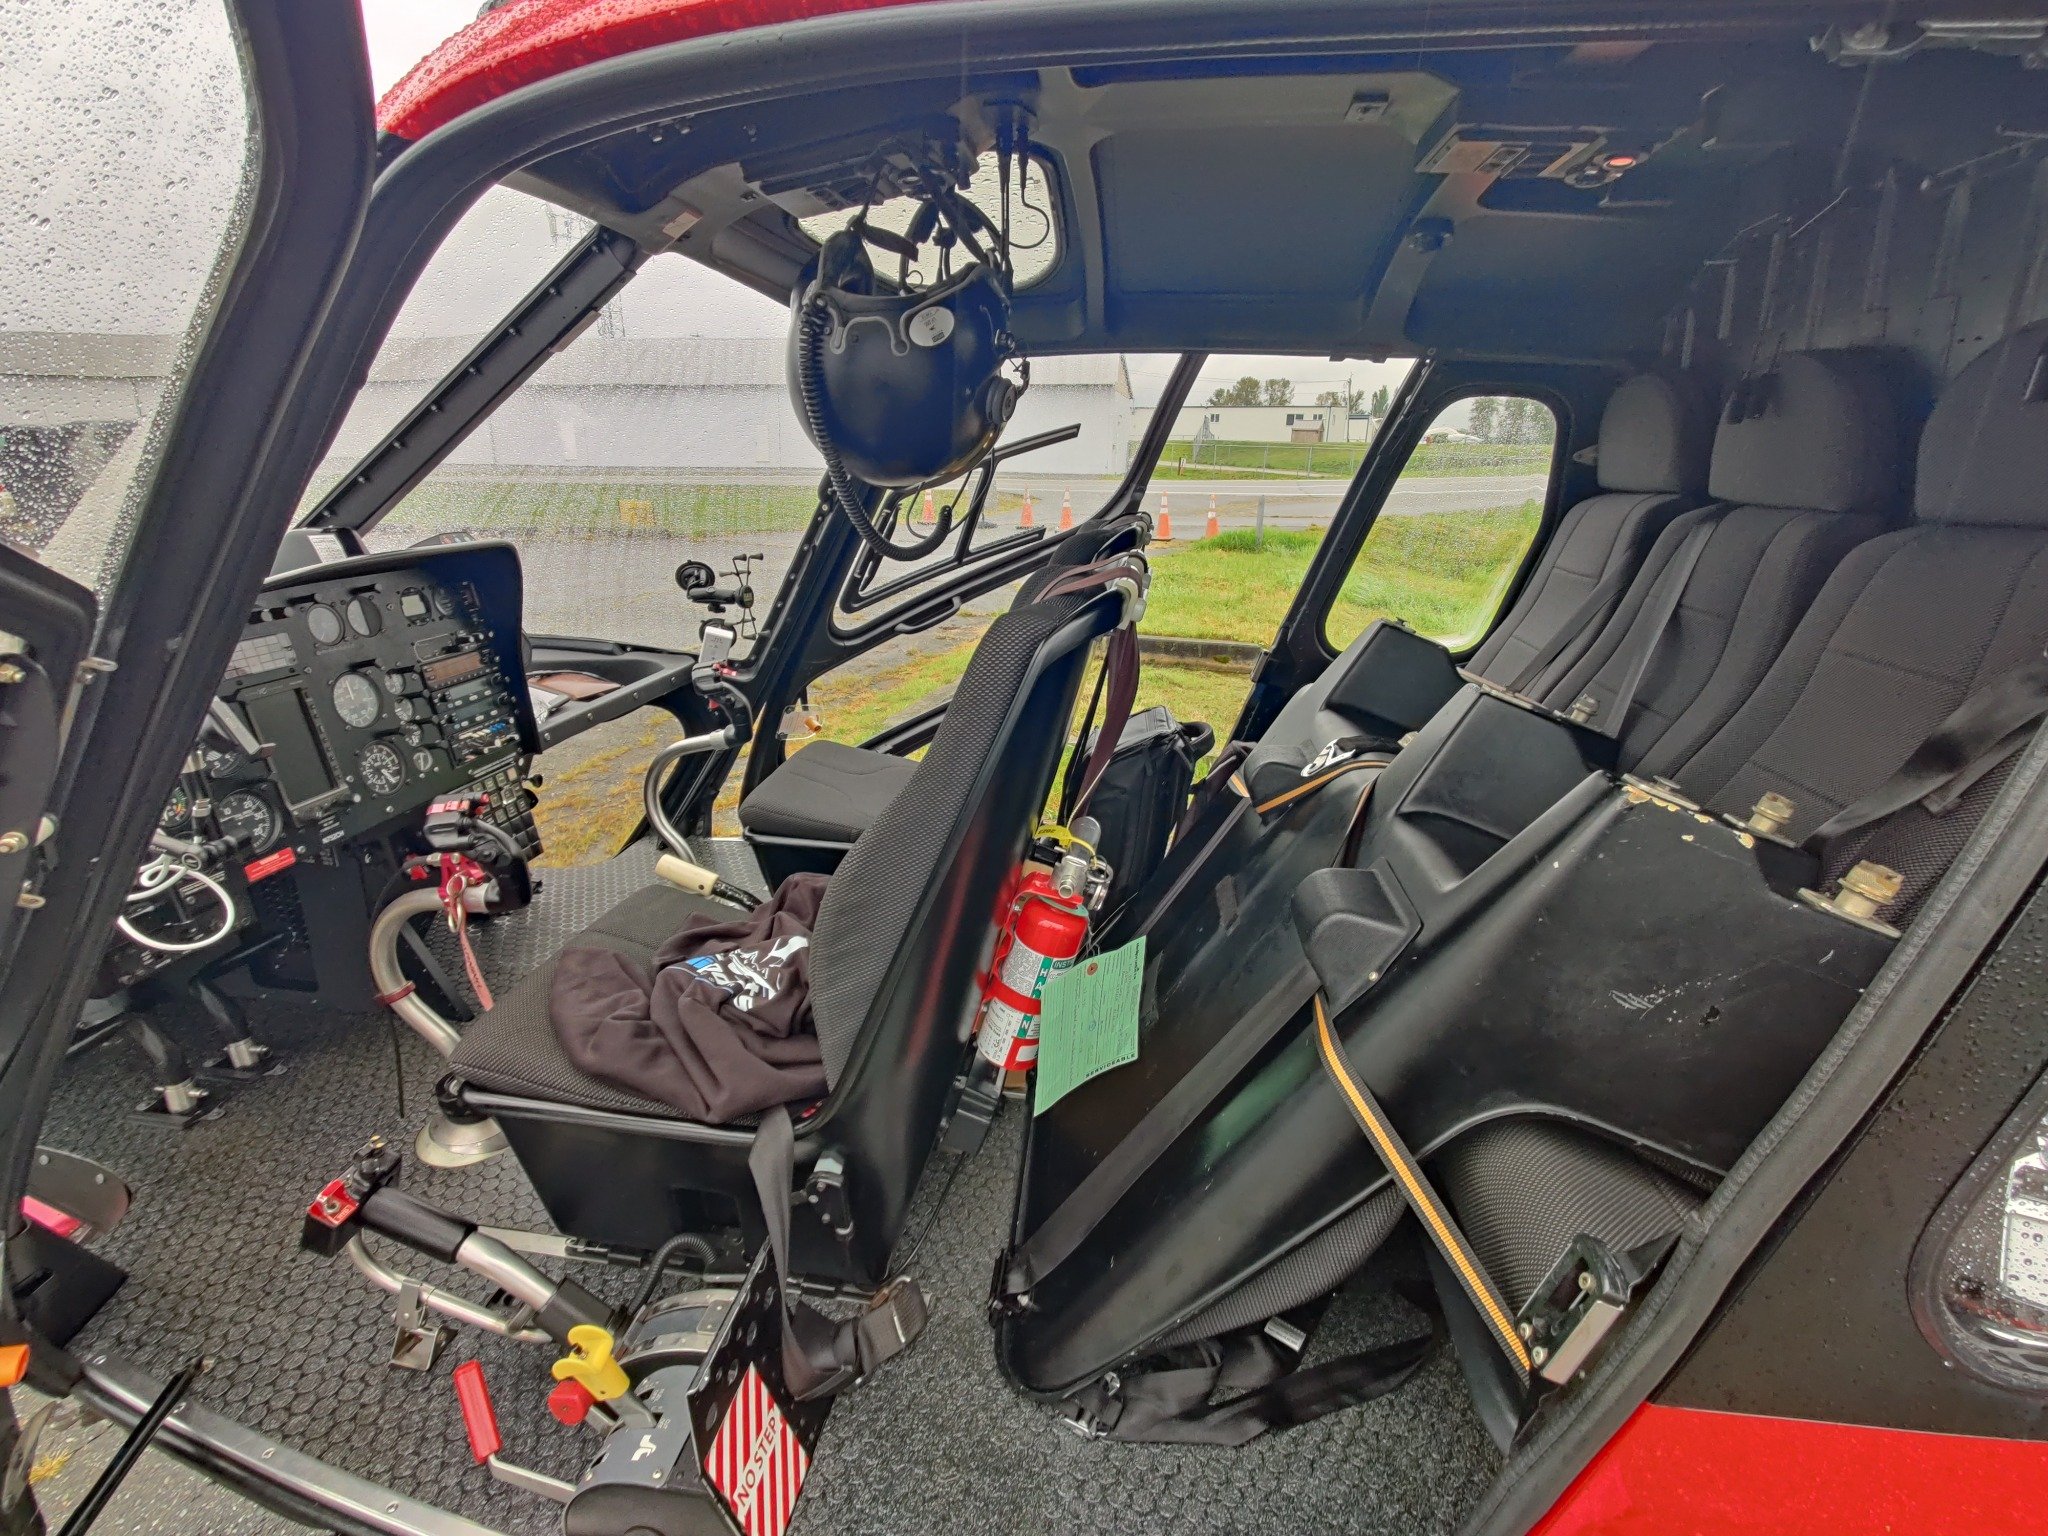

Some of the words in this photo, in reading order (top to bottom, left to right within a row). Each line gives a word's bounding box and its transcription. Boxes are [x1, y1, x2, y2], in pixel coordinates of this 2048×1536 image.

[1085, 1053, 1135, 1078] SERVICEABLE
[738, 1469, 756, 1507] NO
[754, 1416, 777, 1470] STEP
